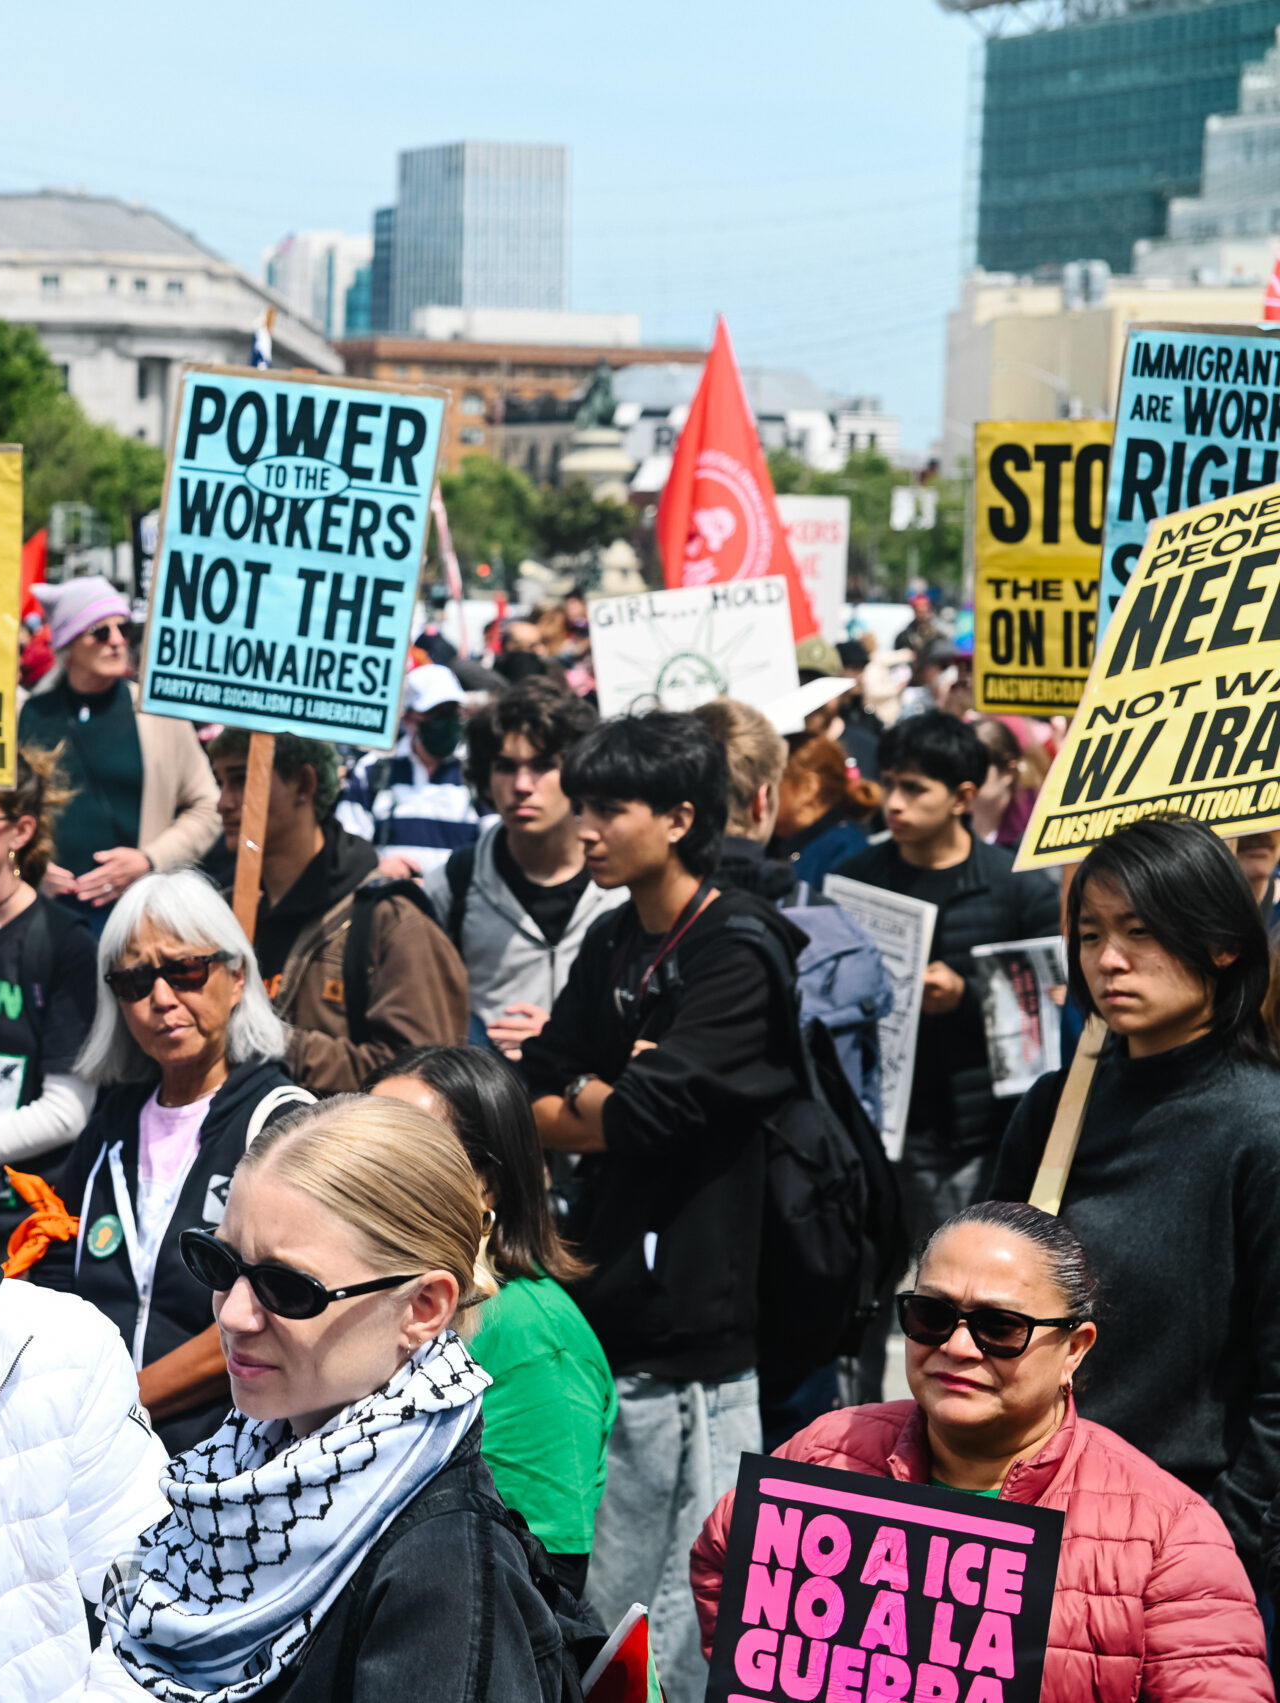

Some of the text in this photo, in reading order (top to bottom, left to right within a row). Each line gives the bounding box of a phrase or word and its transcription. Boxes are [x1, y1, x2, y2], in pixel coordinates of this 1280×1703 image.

[184, 384, 427, 486] POWER
[1130, 394, 1173, 423] ARE
[265, 464, 330, 491] TO THE
[179, 477, 416, 561] WORKERS
[161, 550, 271, 629] NOT
[297, 567, 404, 649] THE
[710, 581, 785, 611] HOLD
[987, 578, 1062, 601] THE
[156, 626, 392, 699] BILLIONAIRES!
[990, 609, 1045, 667] ON
[154, 676, 196, 700] PARTY
[196, 682, 222, 705] FOR
[223, 686, 292, 714] SOCIALISM
[305, 698, 383, 728] LIBERATION
[1085, 680, 1202, 730] NOT
[751, 1502, 1027, 1615] NO A ICE
[741, 1563, 1015, 1679] NO A LA
